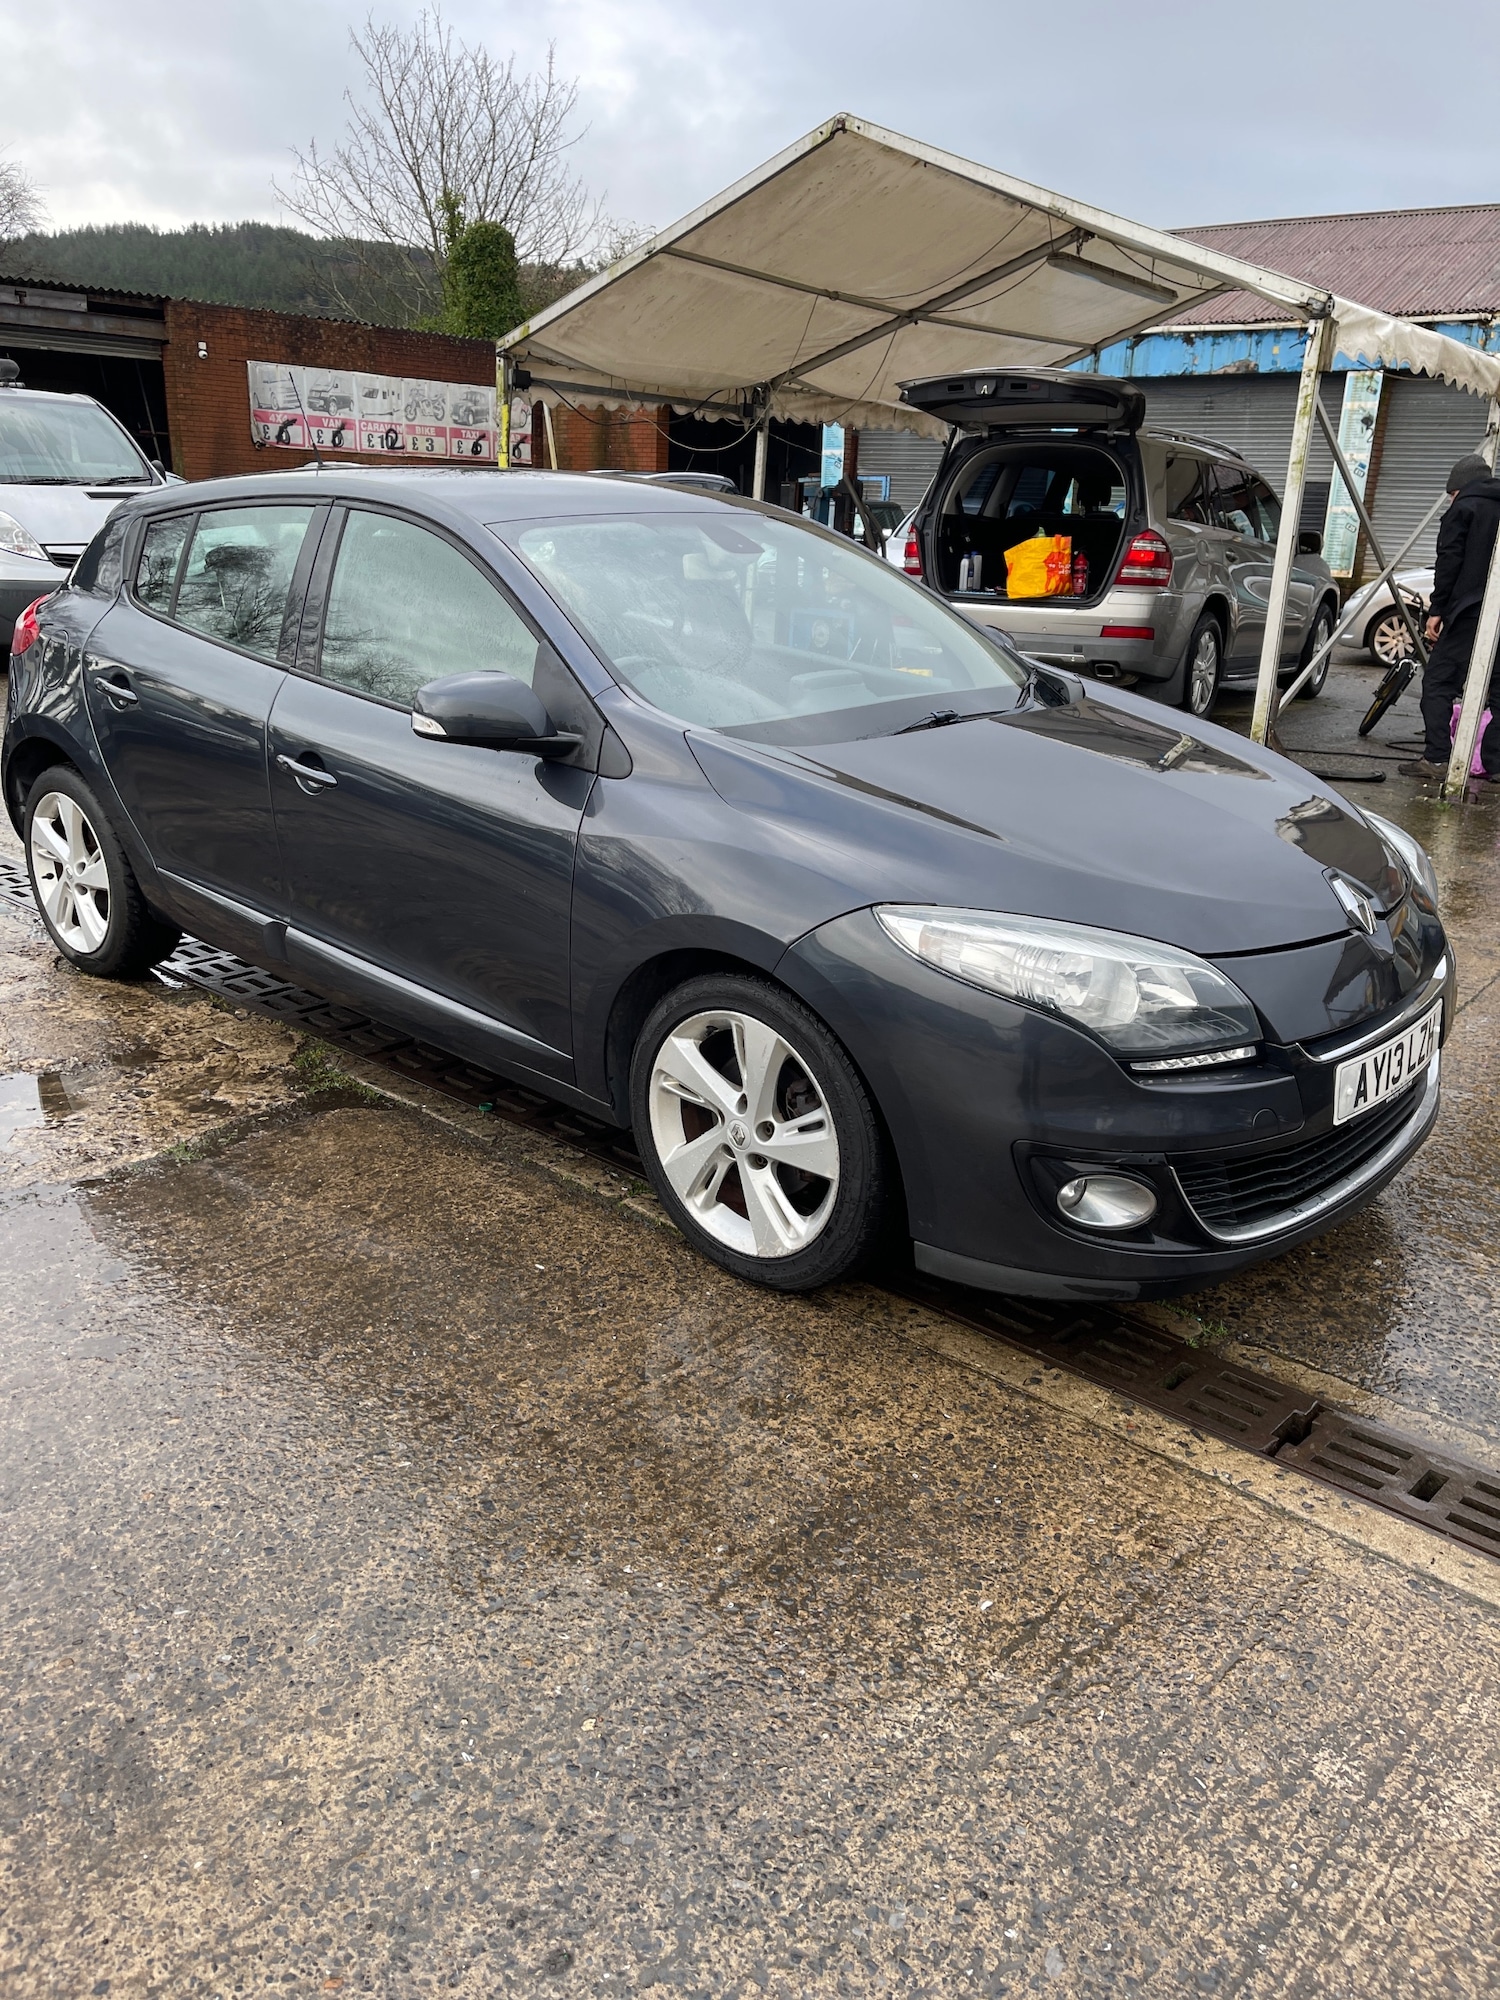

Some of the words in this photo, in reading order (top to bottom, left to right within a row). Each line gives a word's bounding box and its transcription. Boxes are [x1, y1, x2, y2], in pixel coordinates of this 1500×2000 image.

[269, 413, 288, 424] 4X4
[321, 417, 342, 429] VAN
[360, 421, 403, 435] CARAVAN
[415, 425, 436, 436] BIKE
[460, 429, 479, 439] TAXI
[425, 437, 435, 452] 3
[1353, 1041, 1405, 1109] AY13
[1407, 1013, 1436, 1075] LZH
